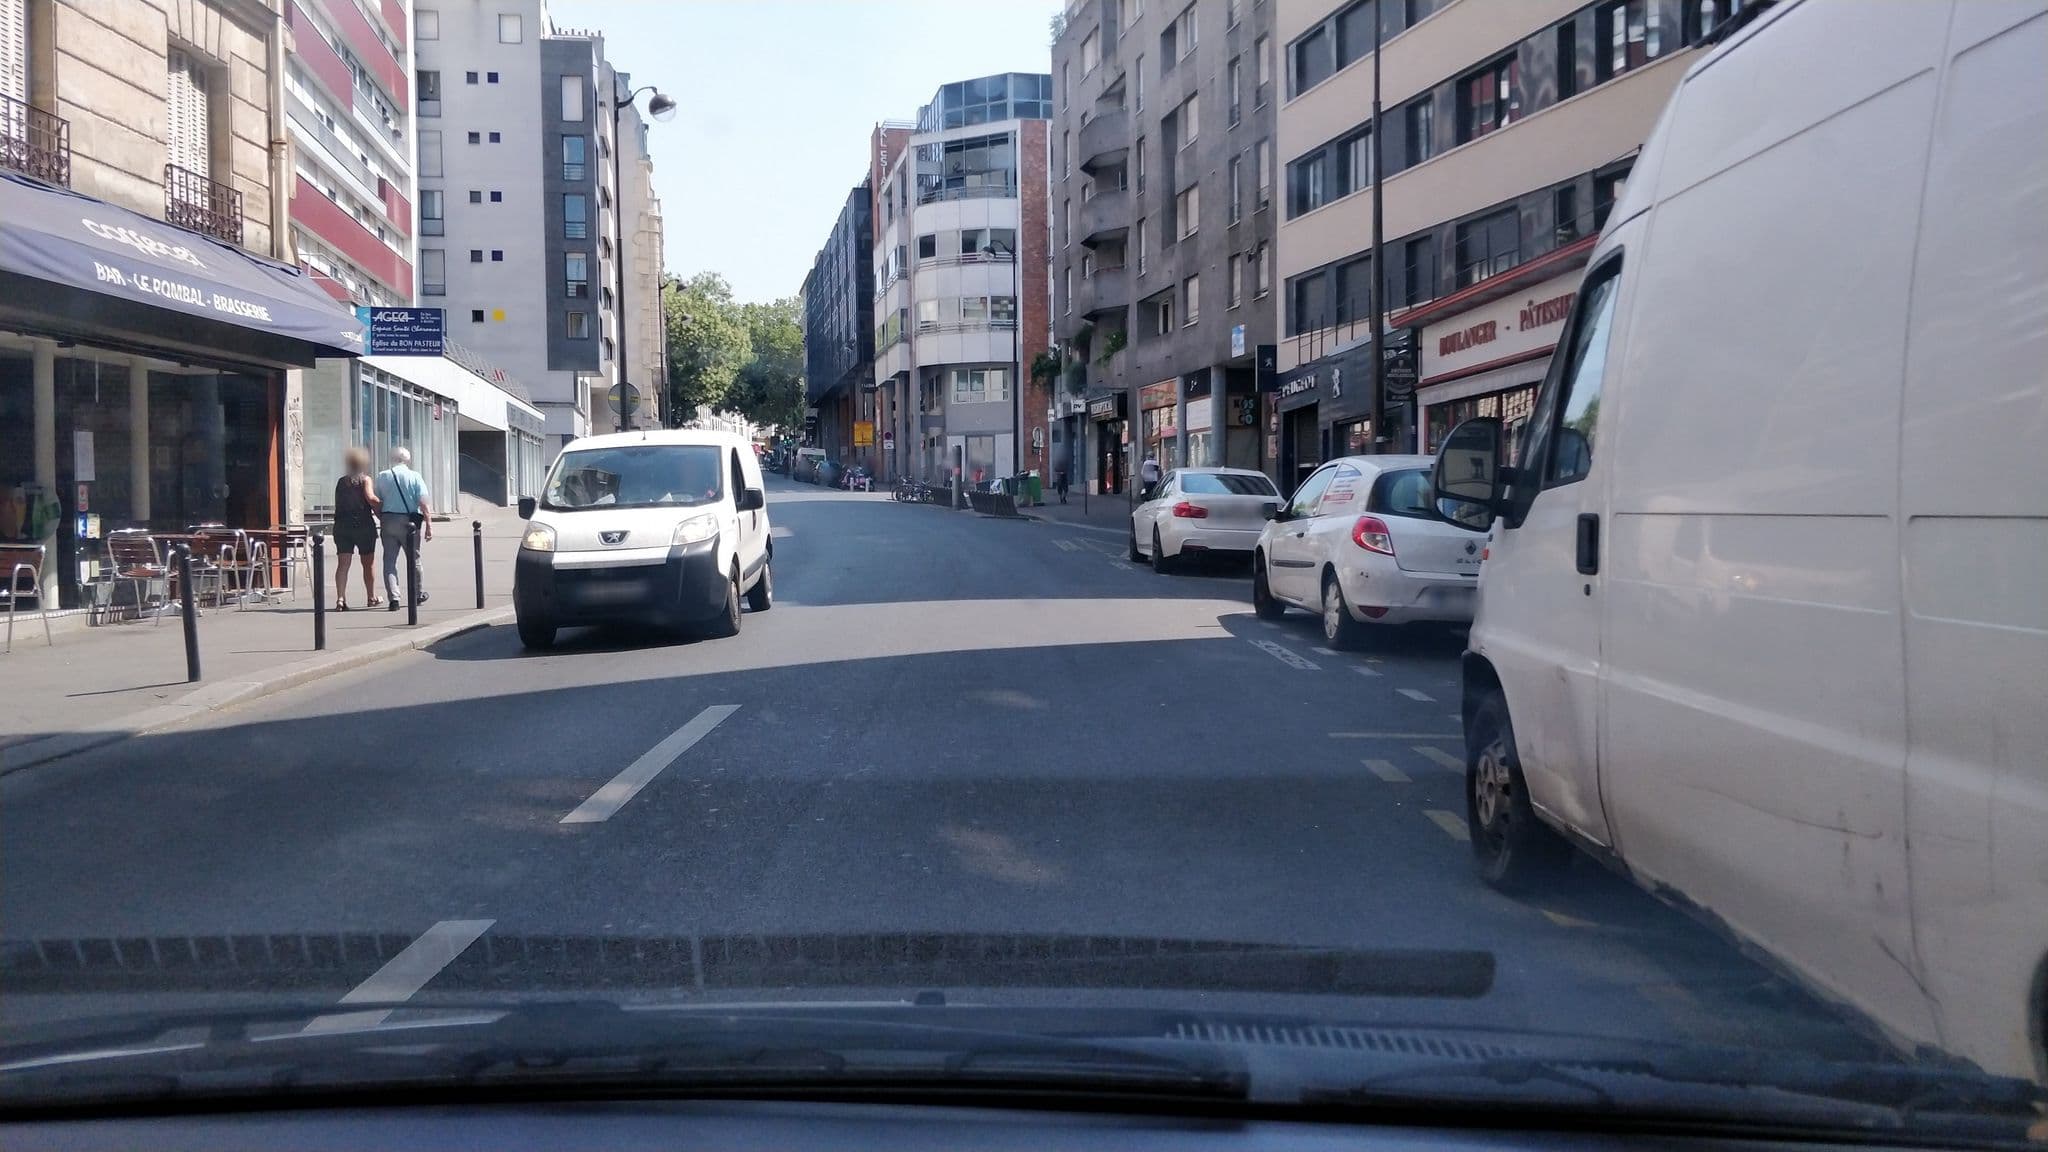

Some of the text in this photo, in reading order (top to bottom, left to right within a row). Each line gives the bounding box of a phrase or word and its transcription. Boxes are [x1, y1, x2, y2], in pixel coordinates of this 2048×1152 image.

[94, 261, 272, 322] BAR LE POMBAL BRASSERIE
[414, 340, 441, 348] PASTEUR
[1281, 375, 1317, 399] PEUGEOT
